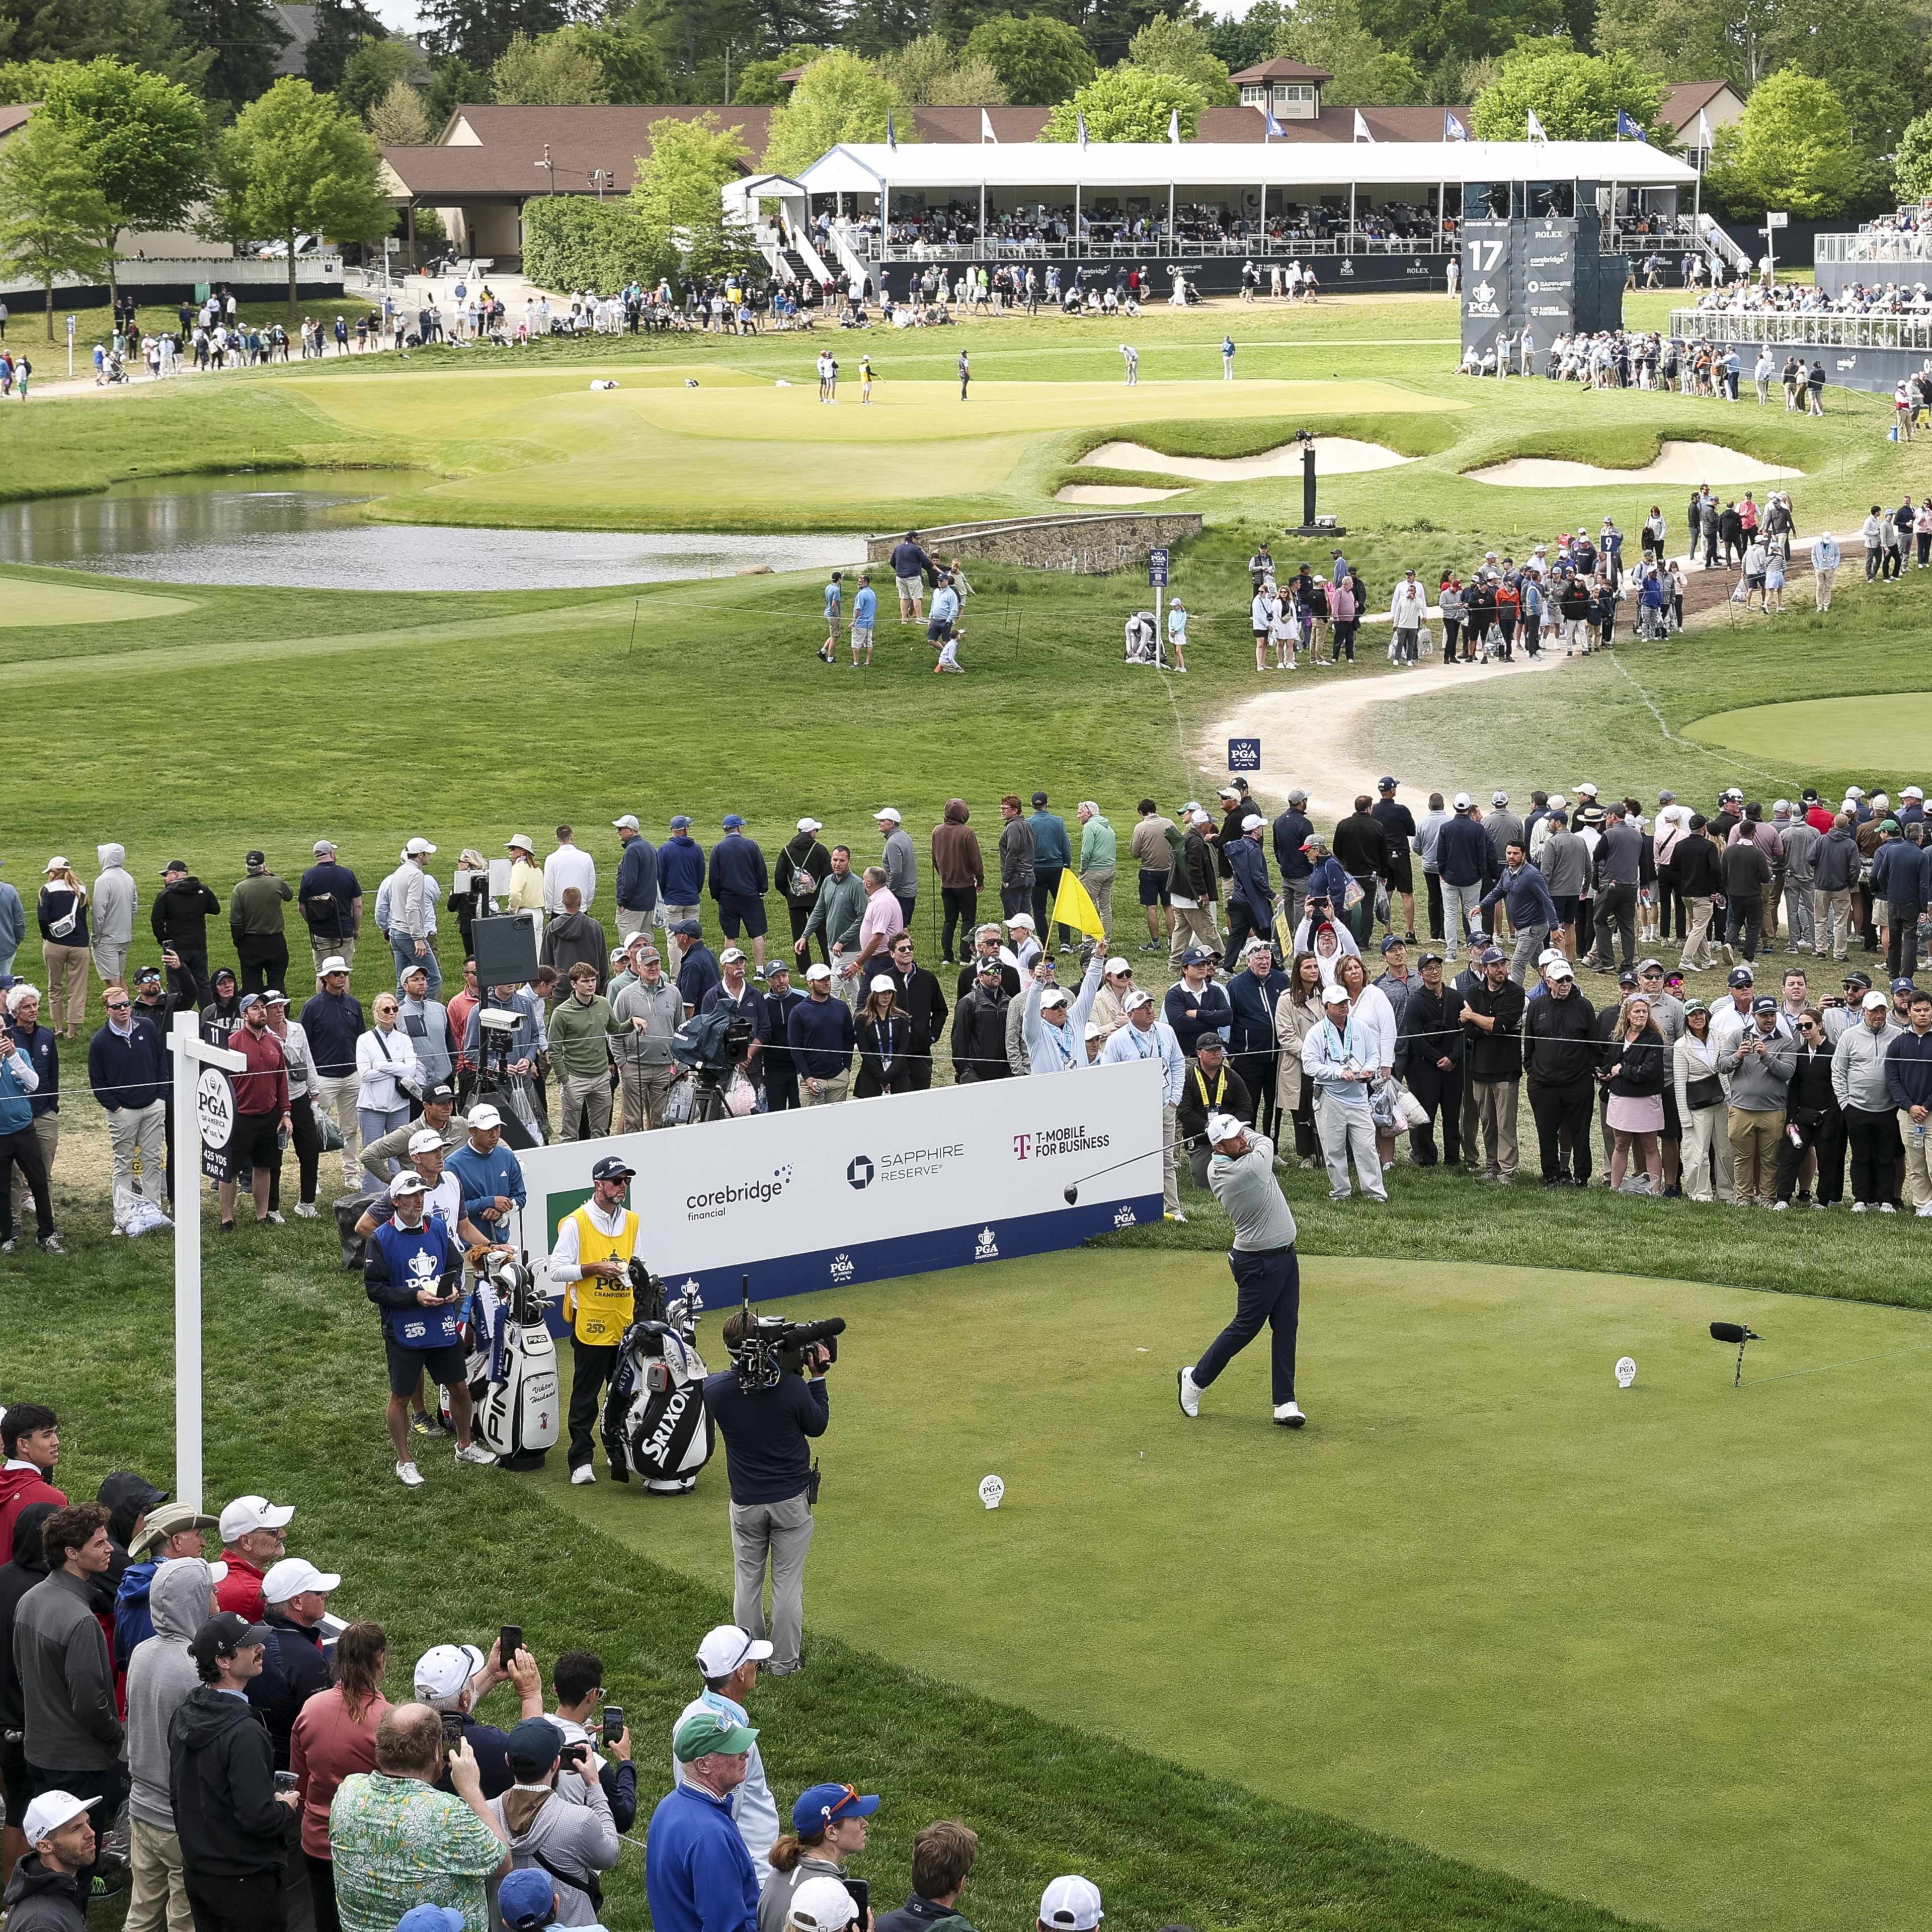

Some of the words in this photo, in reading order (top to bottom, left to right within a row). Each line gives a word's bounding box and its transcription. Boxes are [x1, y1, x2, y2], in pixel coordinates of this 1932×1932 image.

[826, 197, 851, 207] 205
[1468, 240, 1503, 271] 17
[1082, 267, 1108, 275] orebridge
[1468, 302, 1500, 312] PGA
[1605, 537, 1612, 550] 9
[1231, 750, 1258, 758] PGA
[211, 1027, 219, 1044] 11
[198, 1091, 229, 1119] PGA
[1036, 1125, 1085, 1144] T-MOBILE
[1036, 1143, 1057, 1158] FOR
[1059, 1135, 1110, 1155] BUSINESS
[203, 1149, 215, 1161] 425
[215, 1153, 227, 1167] YDS
[881, 1144, 964, 1168] SAPPHIRE
[207, 1162, 218, 1175] PAR
[219, 1168, 224, 1177] 4
[686, 1180, 782, 1209] corebridge
[688, 1207, 726, 1221] financial
[1114, 1213, 1137, 1224] PGA
[975, 1243, 999, 1255] PGA
[830, 1260, 854, 1273] PGA
[405, 1326, 426, 1338] 250
[532, 1383, 554, 1394] Viktor
[488, 1347, 514, 1446] PING
[529, 1388, 556, 1405] Hovland
[642, 1384, 694, 1469] SRIXON
[984, 1484, 1002, 1494] PGA
